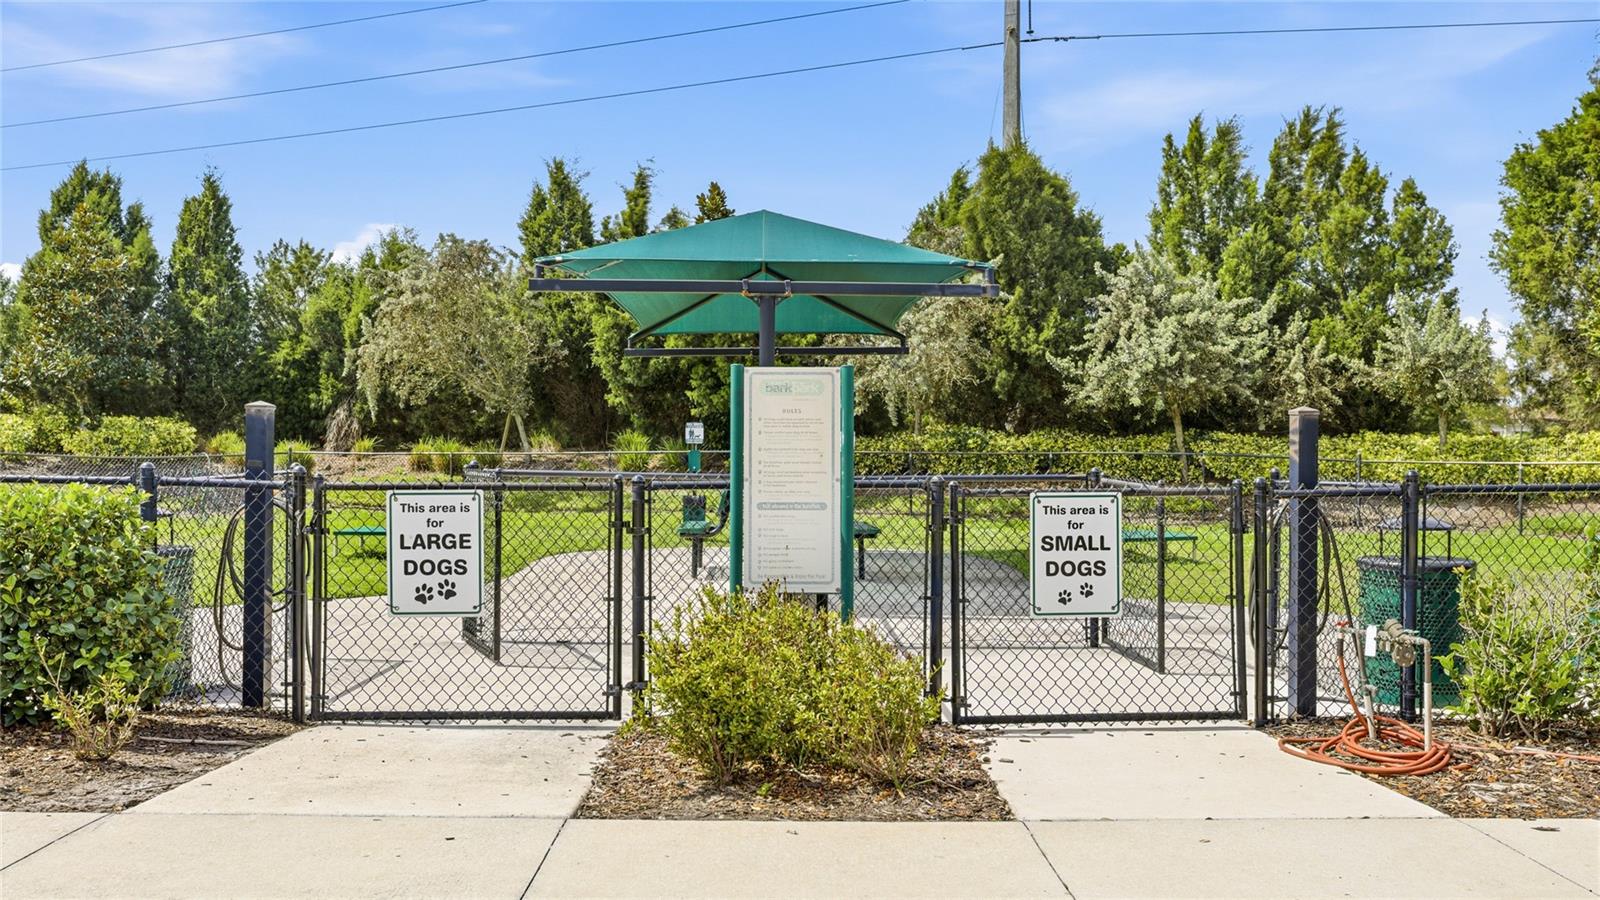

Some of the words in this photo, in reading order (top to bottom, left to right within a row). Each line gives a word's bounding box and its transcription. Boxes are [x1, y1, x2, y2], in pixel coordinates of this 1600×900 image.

[400, 502, 425, 513] This
[429, 504, 456, 513] area
[460, 502, 470, 513] is
[1042, 505, 1067, 515] This
[1070, 506, 1096, 515] area
[1099, 505, 1109, 515] is
[426, 518, 444, 528] for
[1067, 520, 1084, 530] for
[399, 533, 472, 550] LARGE
[1040, 535, 1111, 552] SMALL
[403, 559, 468, 576] DOGS
[1045, 560, 1107, 577] DOGS
